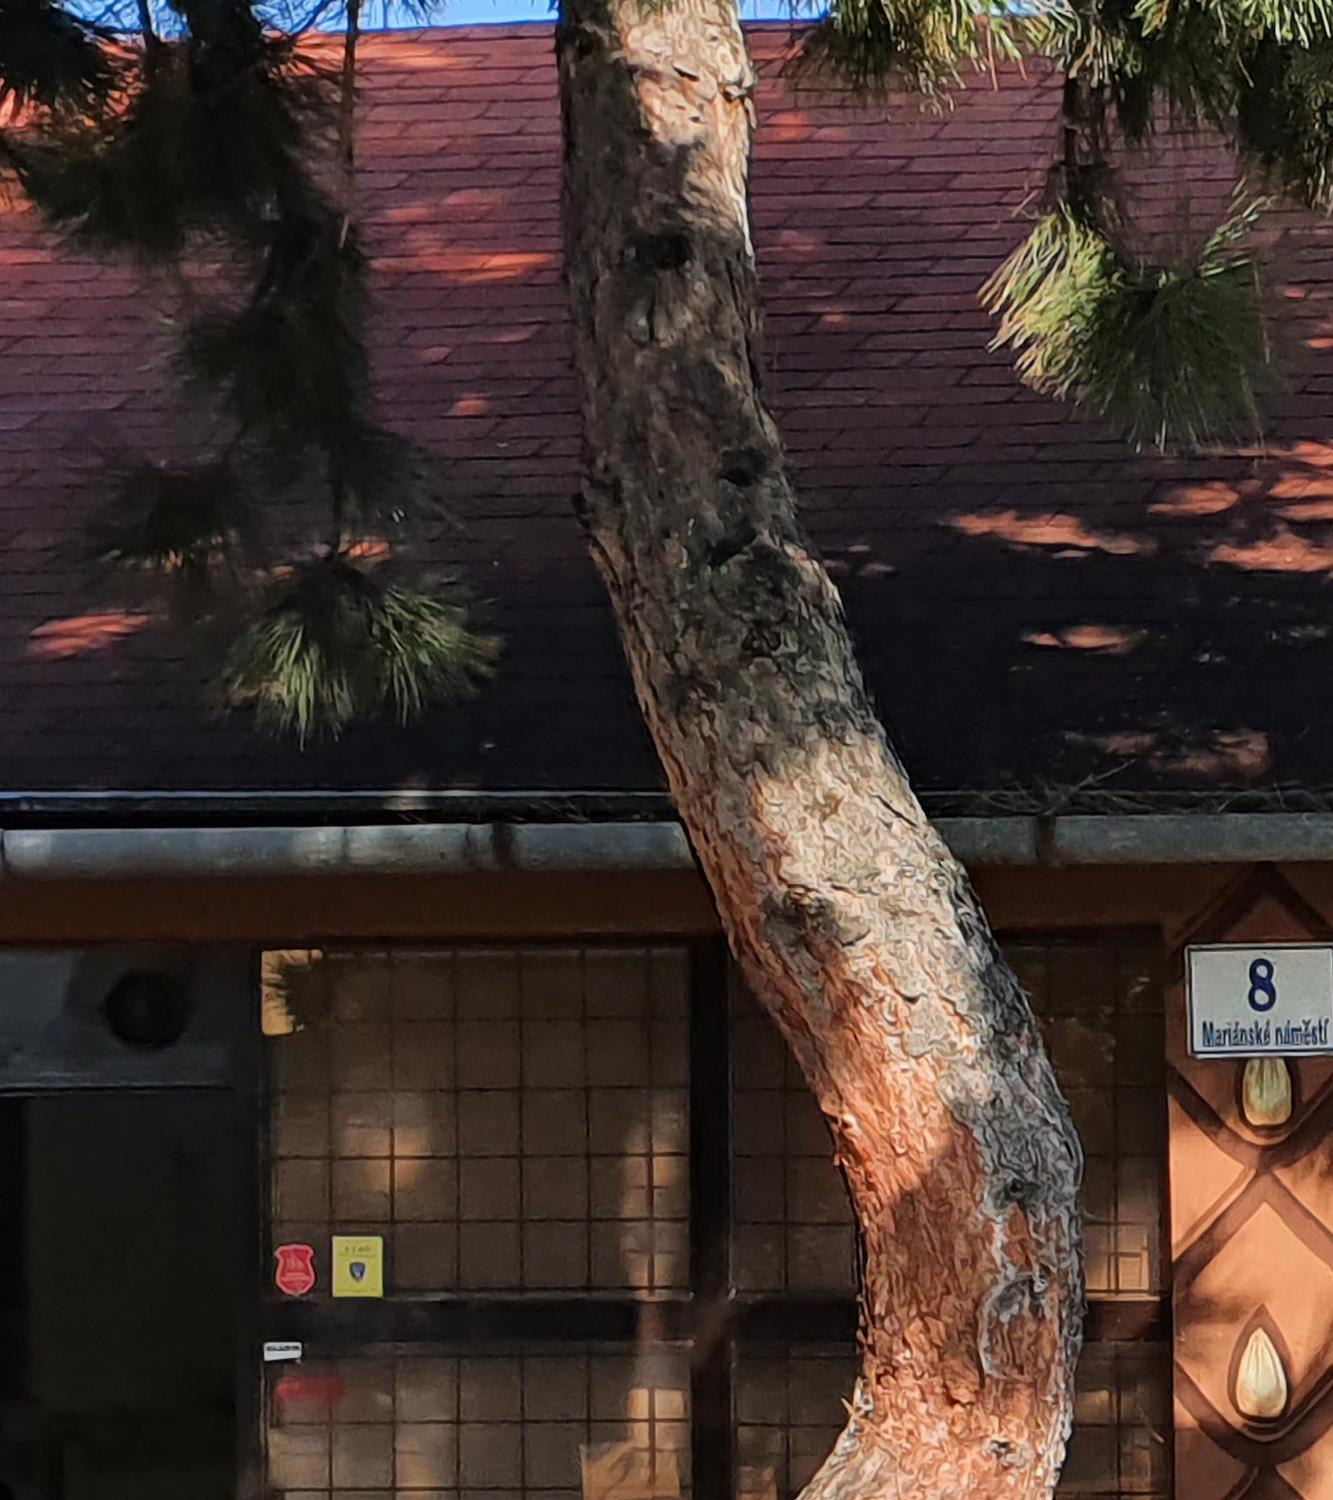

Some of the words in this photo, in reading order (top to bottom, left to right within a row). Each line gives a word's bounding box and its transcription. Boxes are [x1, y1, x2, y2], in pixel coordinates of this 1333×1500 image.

[1248, 958, 1276, 1012] 8
[1203, 1019, 1270, 1047] Mariánské
[1275, 1018, 1329, 1046] náměstí
